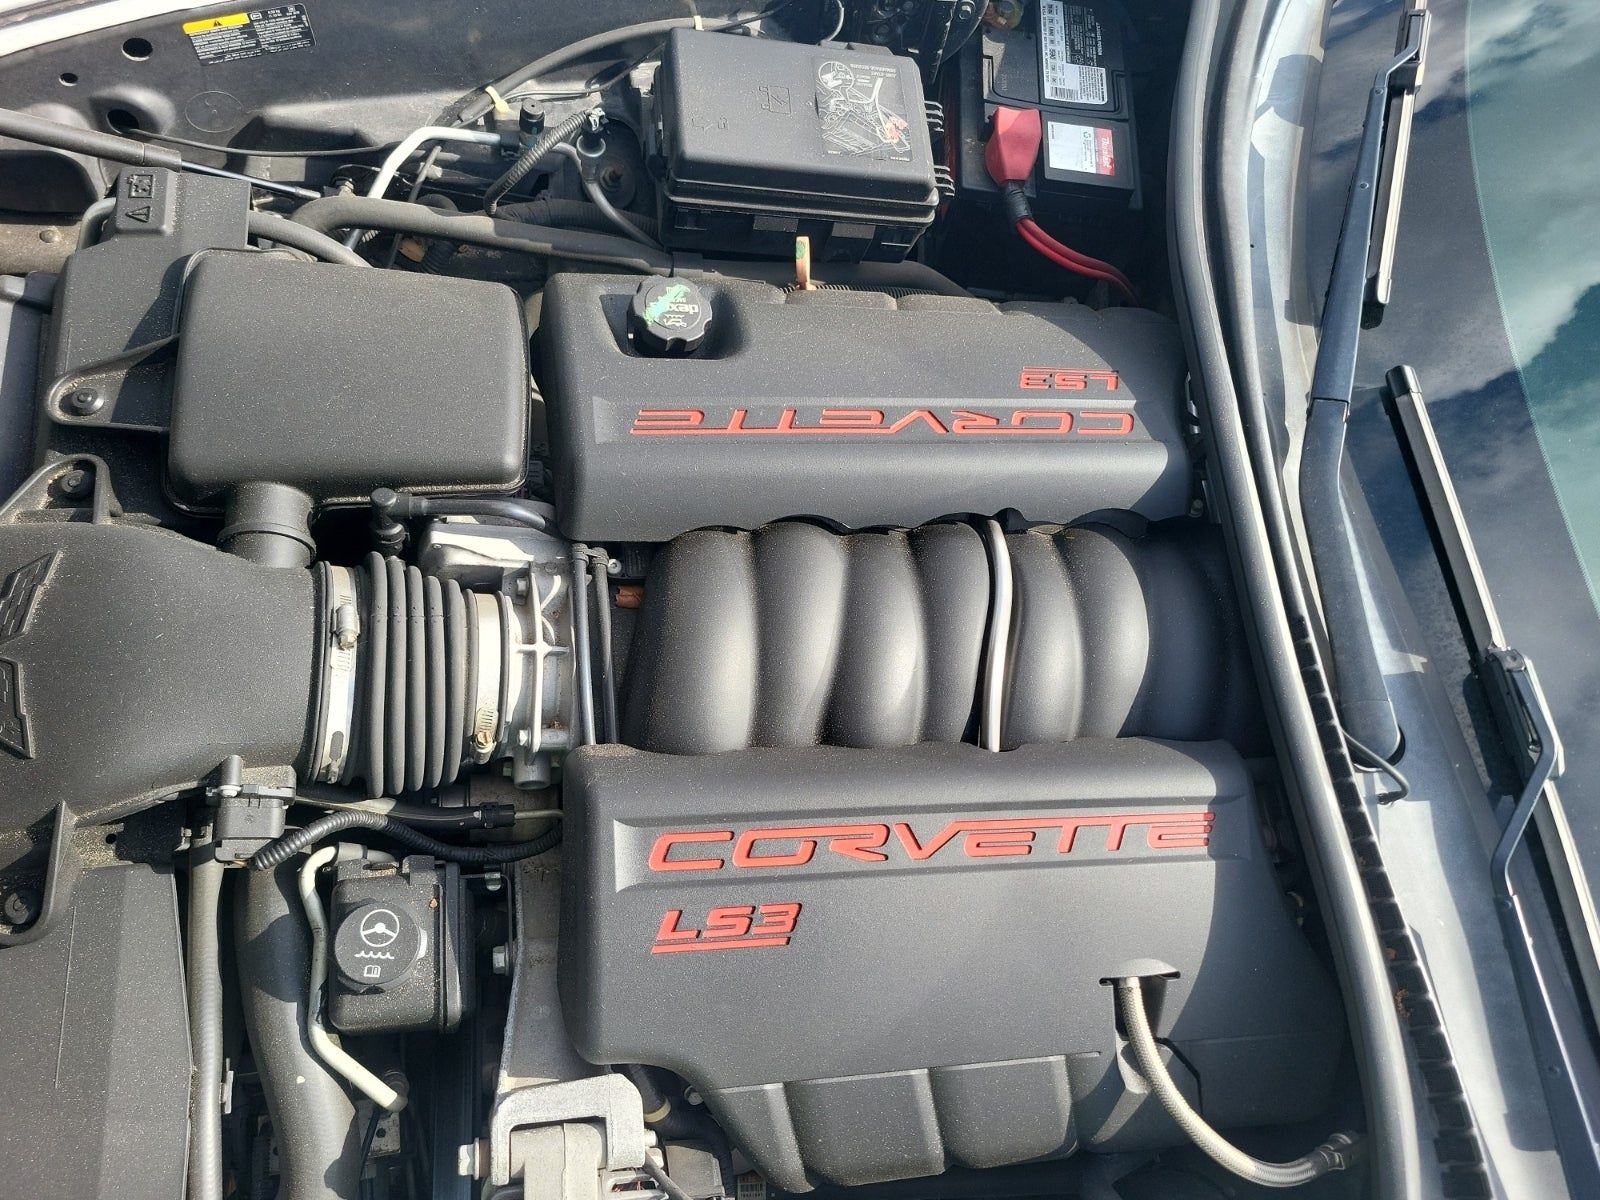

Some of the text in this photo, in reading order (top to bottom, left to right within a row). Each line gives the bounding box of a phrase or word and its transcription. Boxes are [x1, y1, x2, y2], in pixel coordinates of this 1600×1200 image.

[1020, 370, 1118, 391] LS3
[630, 409, 1134, 436] CORVETTE
[649, 811, 1216, 872] CORVETTE
[653, 902, 802, 946] LS3
